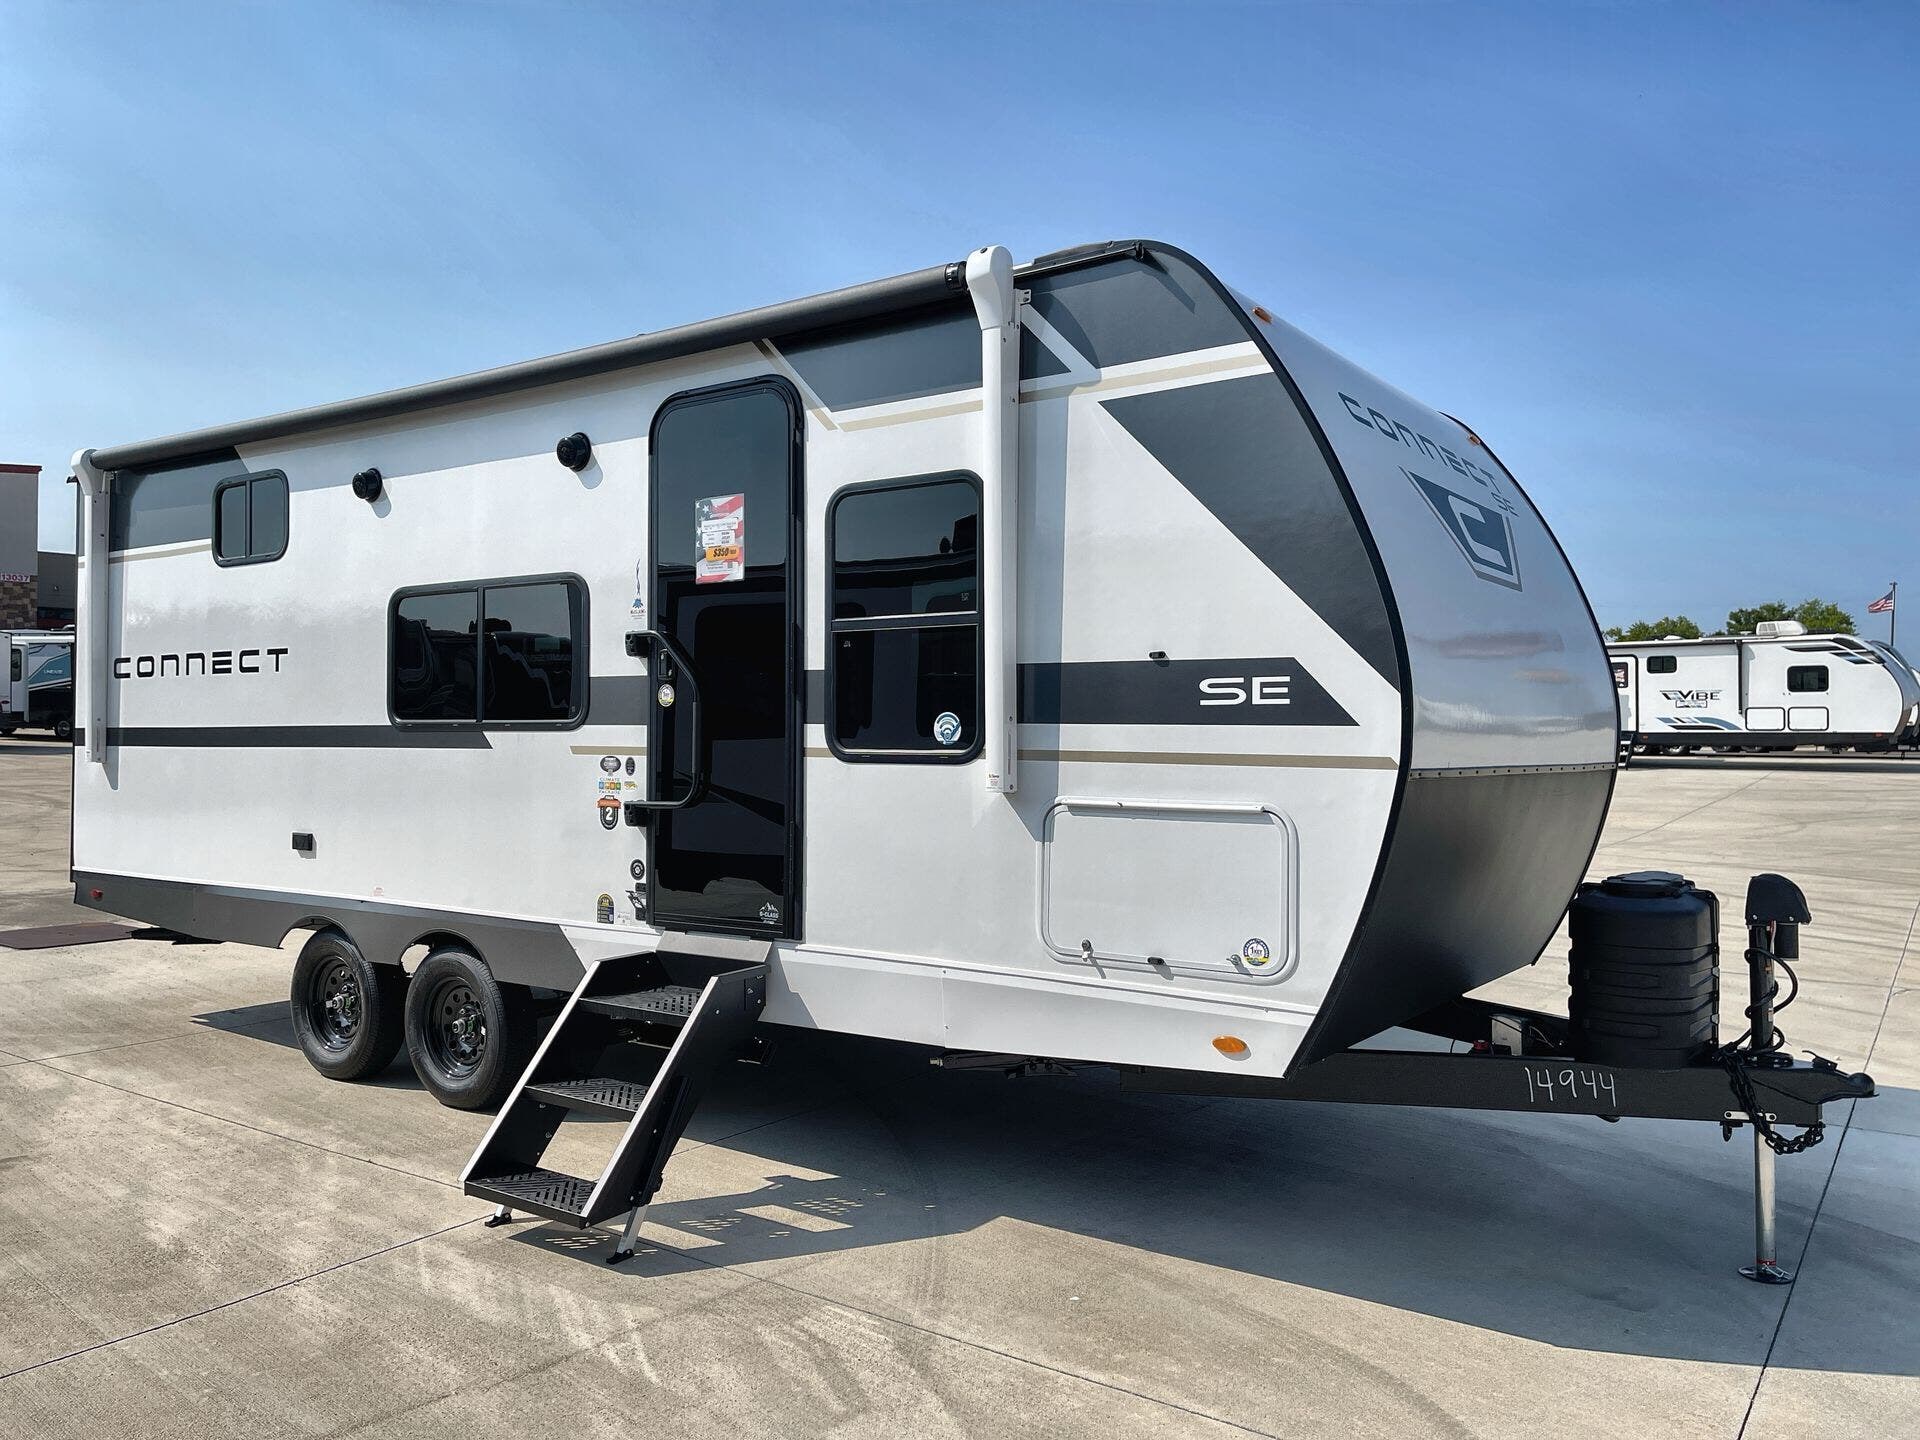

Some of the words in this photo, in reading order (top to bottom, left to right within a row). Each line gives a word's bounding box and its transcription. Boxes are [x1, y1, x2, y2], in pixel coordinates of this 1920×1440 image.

[1338, 392, 1502, 494] CONNECT
[1490, 491, 1520, 517] SE
[713, 547, 730, 558] $350
[1, 574, 30, 582] 13037
[113, 648, 289, 679] CONNECT
[1199, 676, 1291, 706] SE
[1678, 690, 1721, 701] VIBE
[605, 806, 613, 821] 2
[1524, 1066, 1616, 1107] 14944
